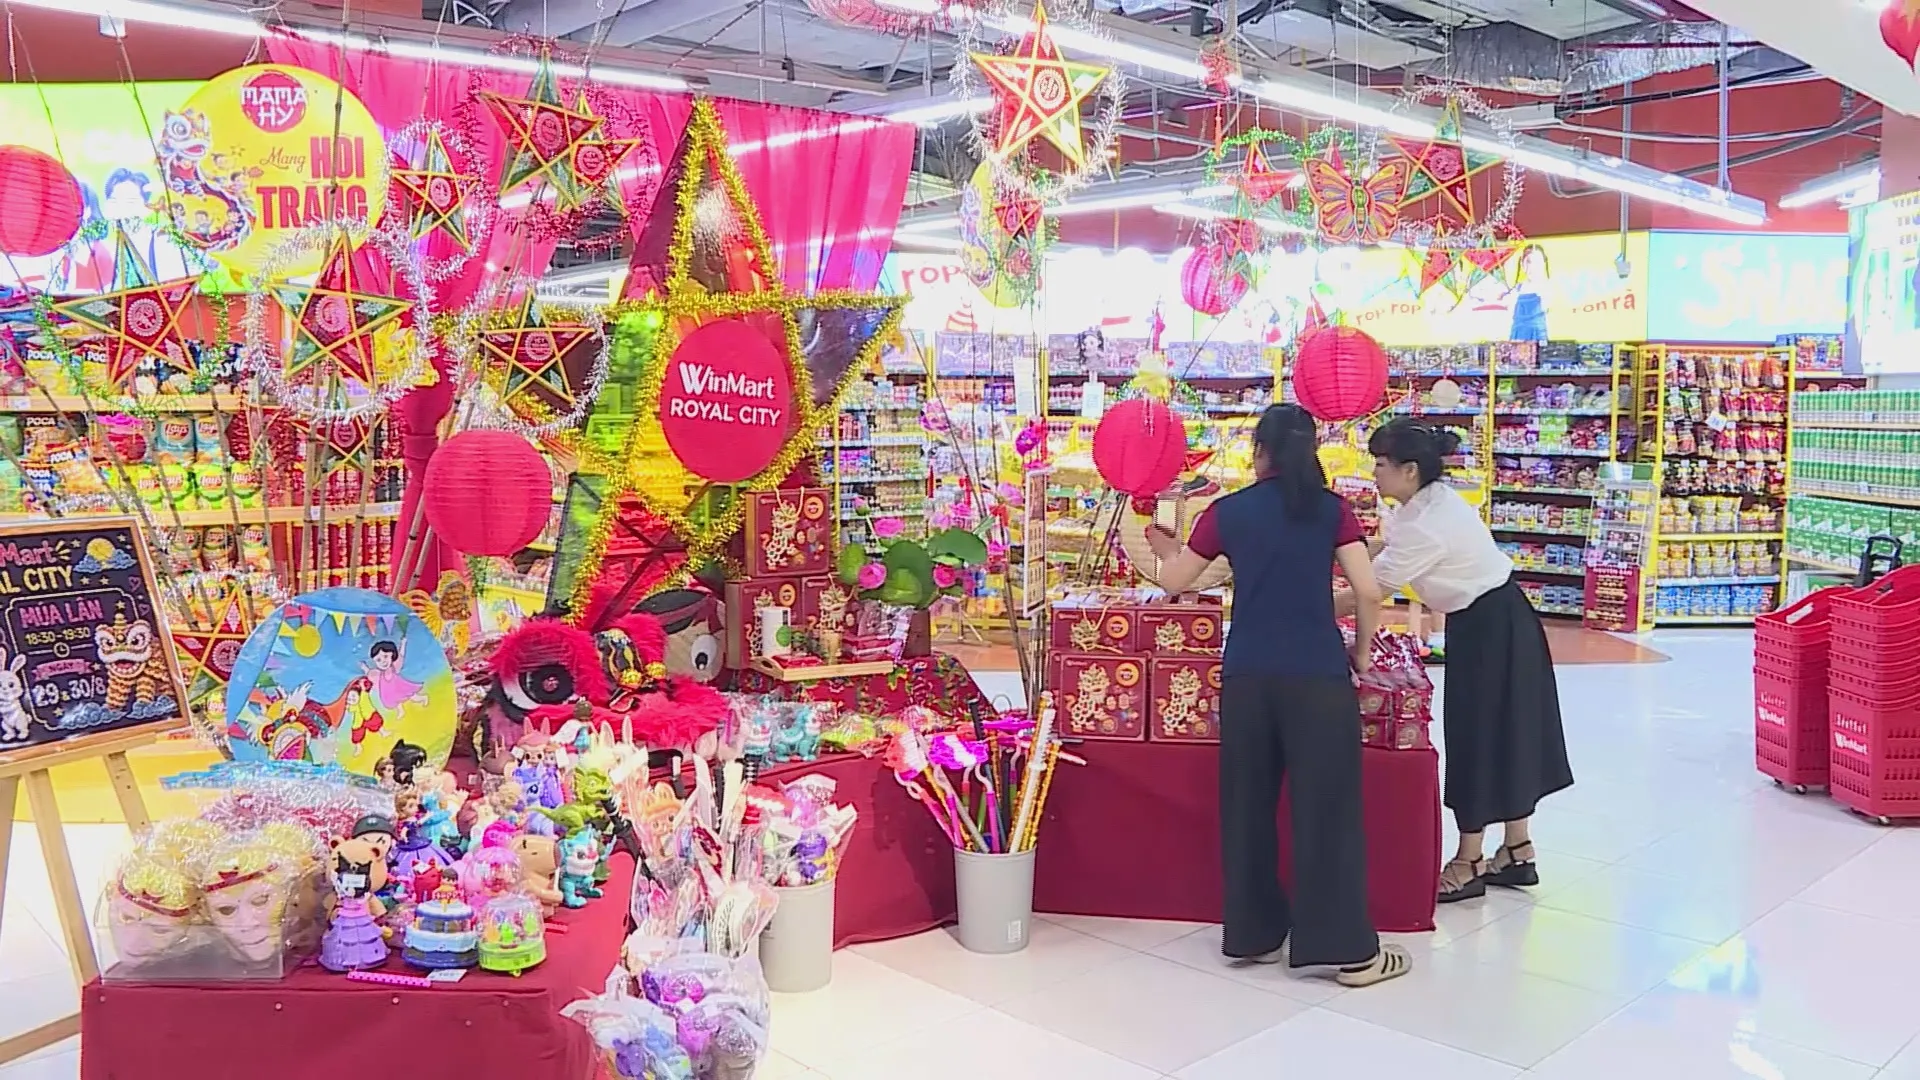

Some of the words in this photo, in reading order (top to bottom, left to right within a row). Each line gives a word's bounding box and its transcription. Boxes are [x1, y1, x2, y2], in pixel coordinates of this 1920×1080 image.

[258, 106, 294, 126] HY
[260, 147, 306, 173] Mang
[87, 351, 107, 363] POC
[679, 362, 775, 399] WinMart
[670, 398, 734, 422] ROYAL
[740, 406, 780, 427] CITY
[23, 564, 73, 592] CITY
[65, 597, 103, 623] LÂN
[31, 683, 59, 707] 29
[68, 675, 106, 700] 30/8
